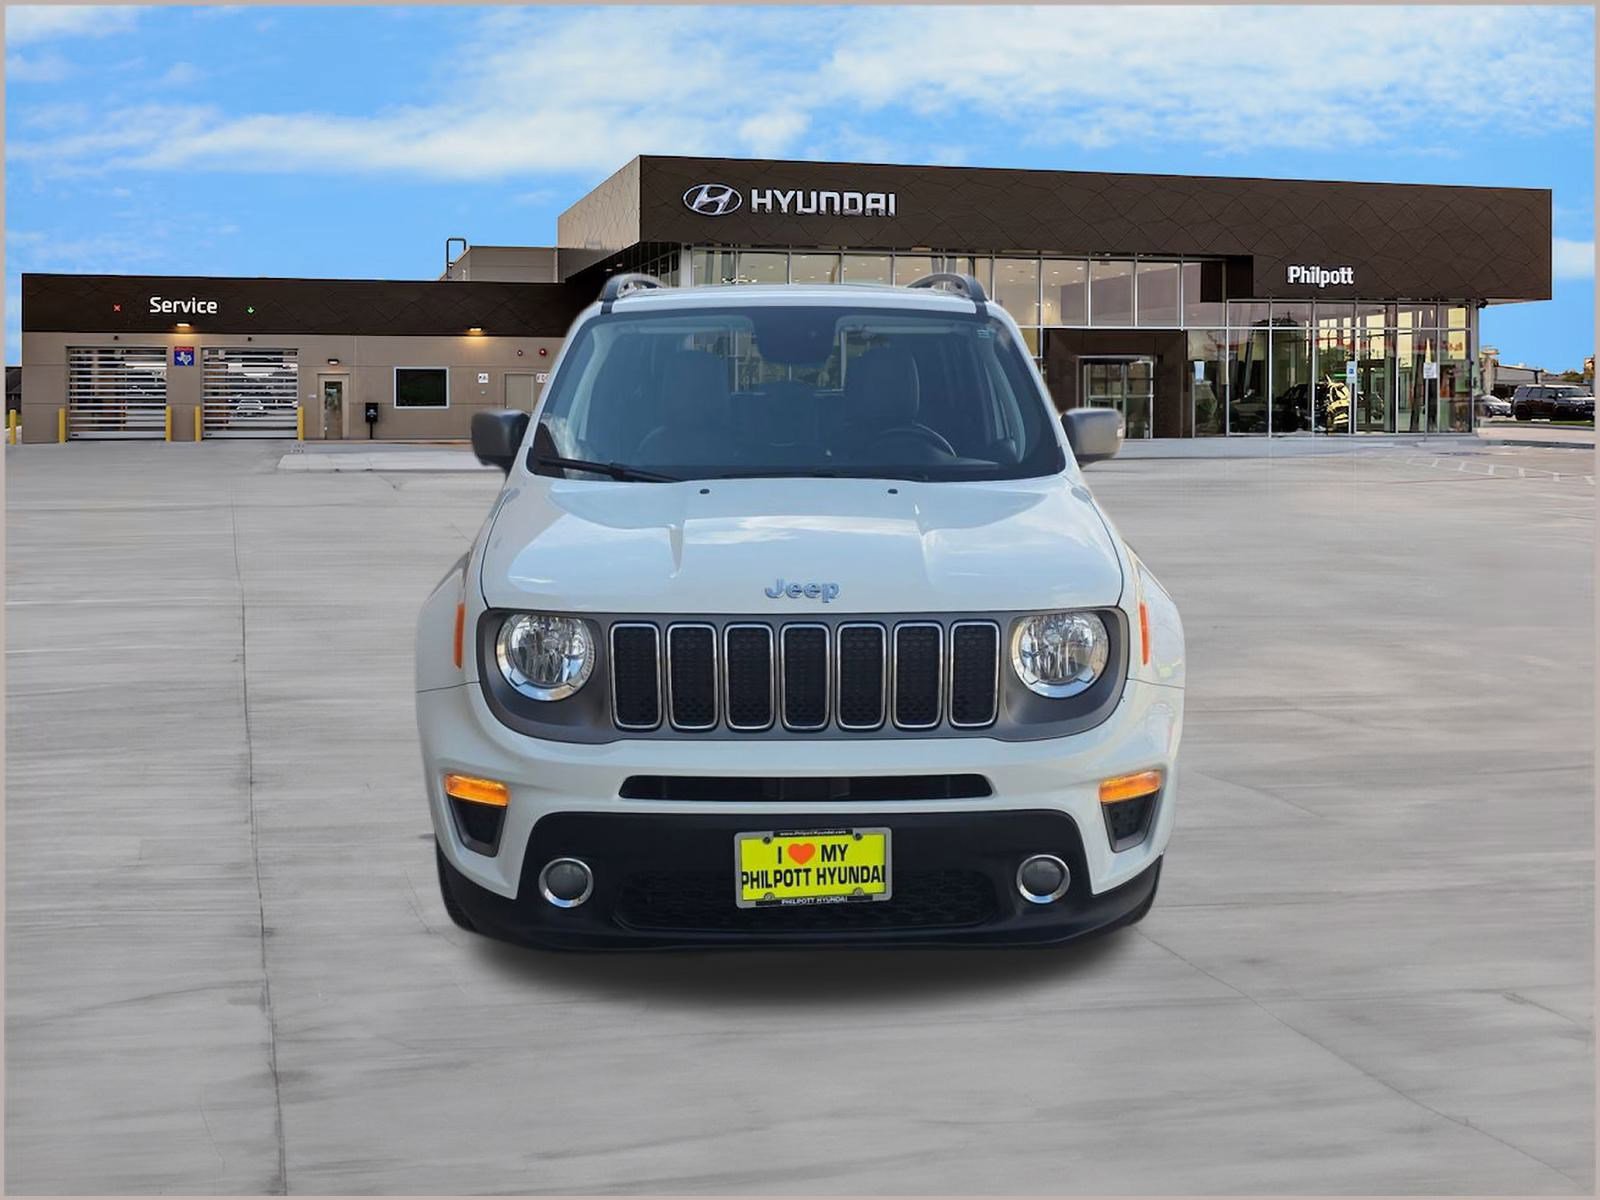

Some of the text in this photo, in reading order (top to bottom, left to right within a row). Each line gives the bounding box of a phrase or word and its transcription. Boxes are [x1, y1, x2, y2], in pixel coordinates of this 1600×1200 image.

[751, 188, 897, 217] HYUNDAI
[1287, 265, 1354, 288] Philpott
[149, 296, 218, 314] Service
[764, 578, 840, 604] Jeep
[777, 843, 849, 864] I MY
[741, 864, 886, 890] PHILPOTT HYUNDAI
